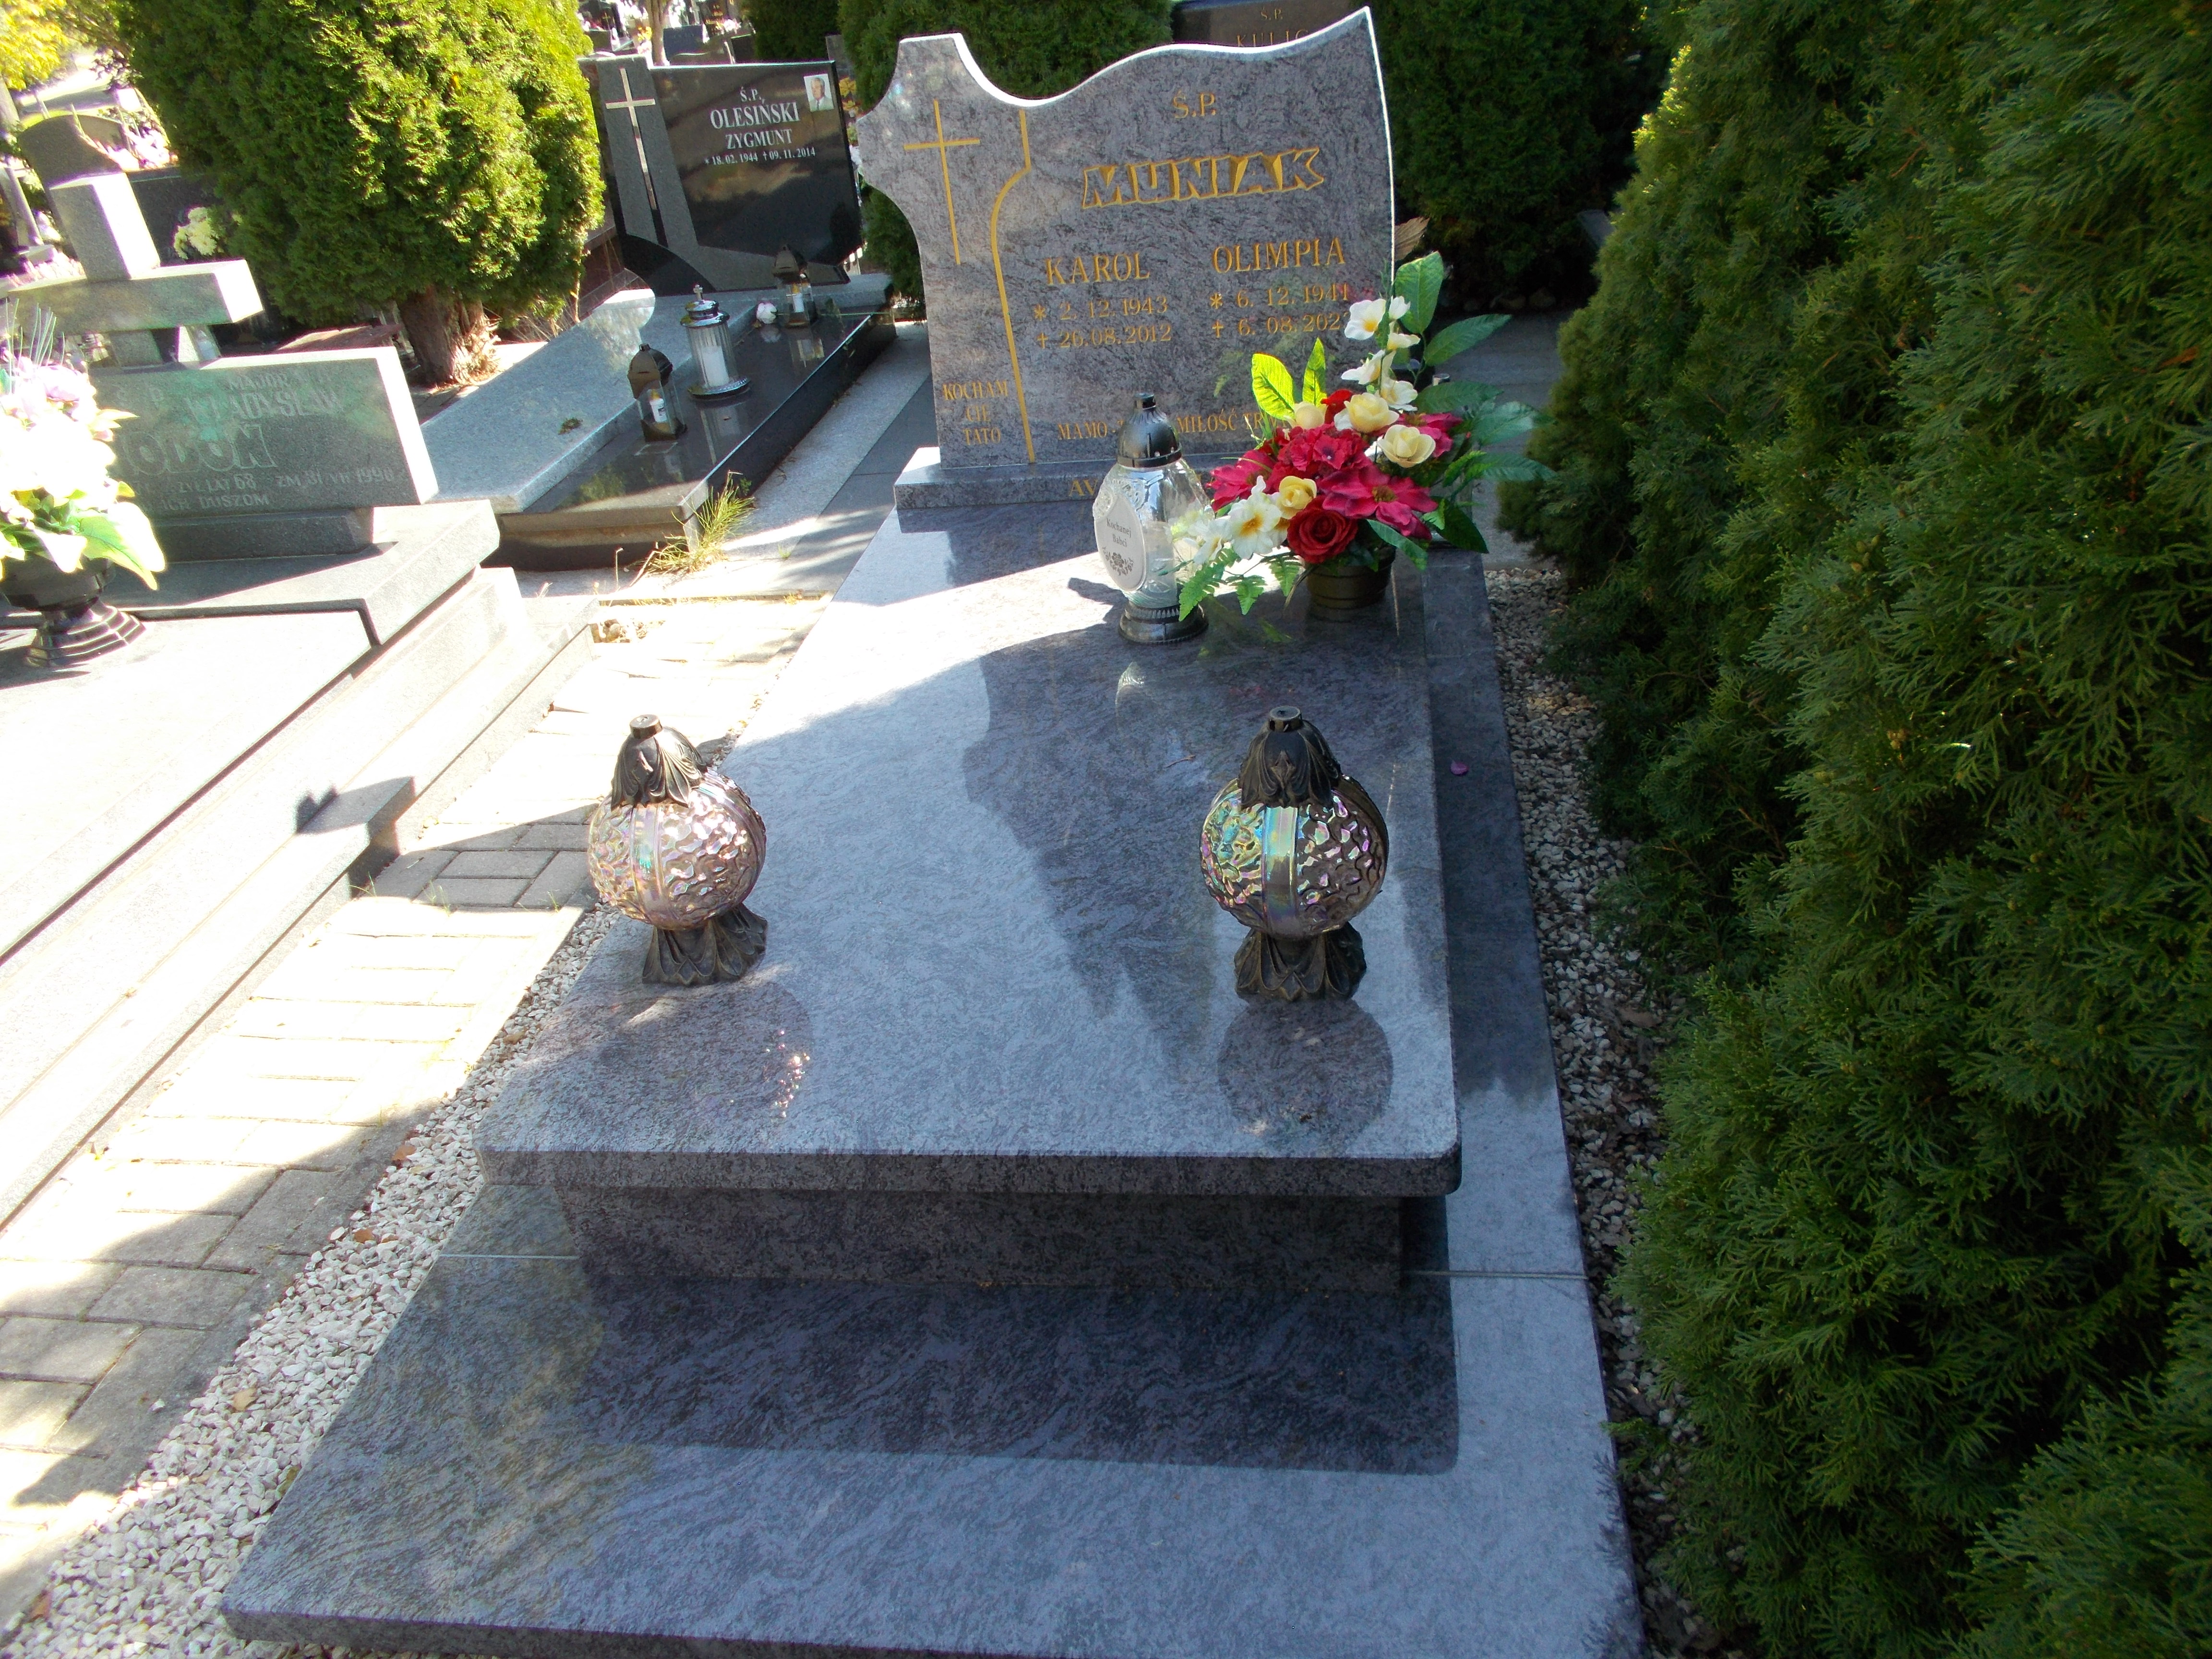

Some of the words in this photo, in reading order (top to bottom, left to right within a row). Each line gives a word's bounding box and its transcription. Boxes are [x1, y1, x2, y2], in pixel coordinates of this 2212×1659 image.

[740, 86, 761, 102] Ś.P.
[1172, 89, 1216, 119] Ś.P.
[710, 98, 801, 129] OLESIŃSKI
[725, 129, 792, 149] ZYGMUNT
[796, 146, 816, 157] 2014
[1082, 147, 1324, 209] MUNIAK
[1212, 237, 1346, 273] OLIMPIA
[1045, 252, 1151, 286] KAROL
[1302, 311, 1350, 332] 202
[942, 379, 1009, 400] KOCHAM
[1058, 421, 1107, 440] MAMO
[1177, 408, 1238, 433] MIŁOŚĆ
[963, 427, 1002, 445] TATO
[1106, 518, 1131, 538] Kochanej
[1112, 534, 1127, 547] Babci
